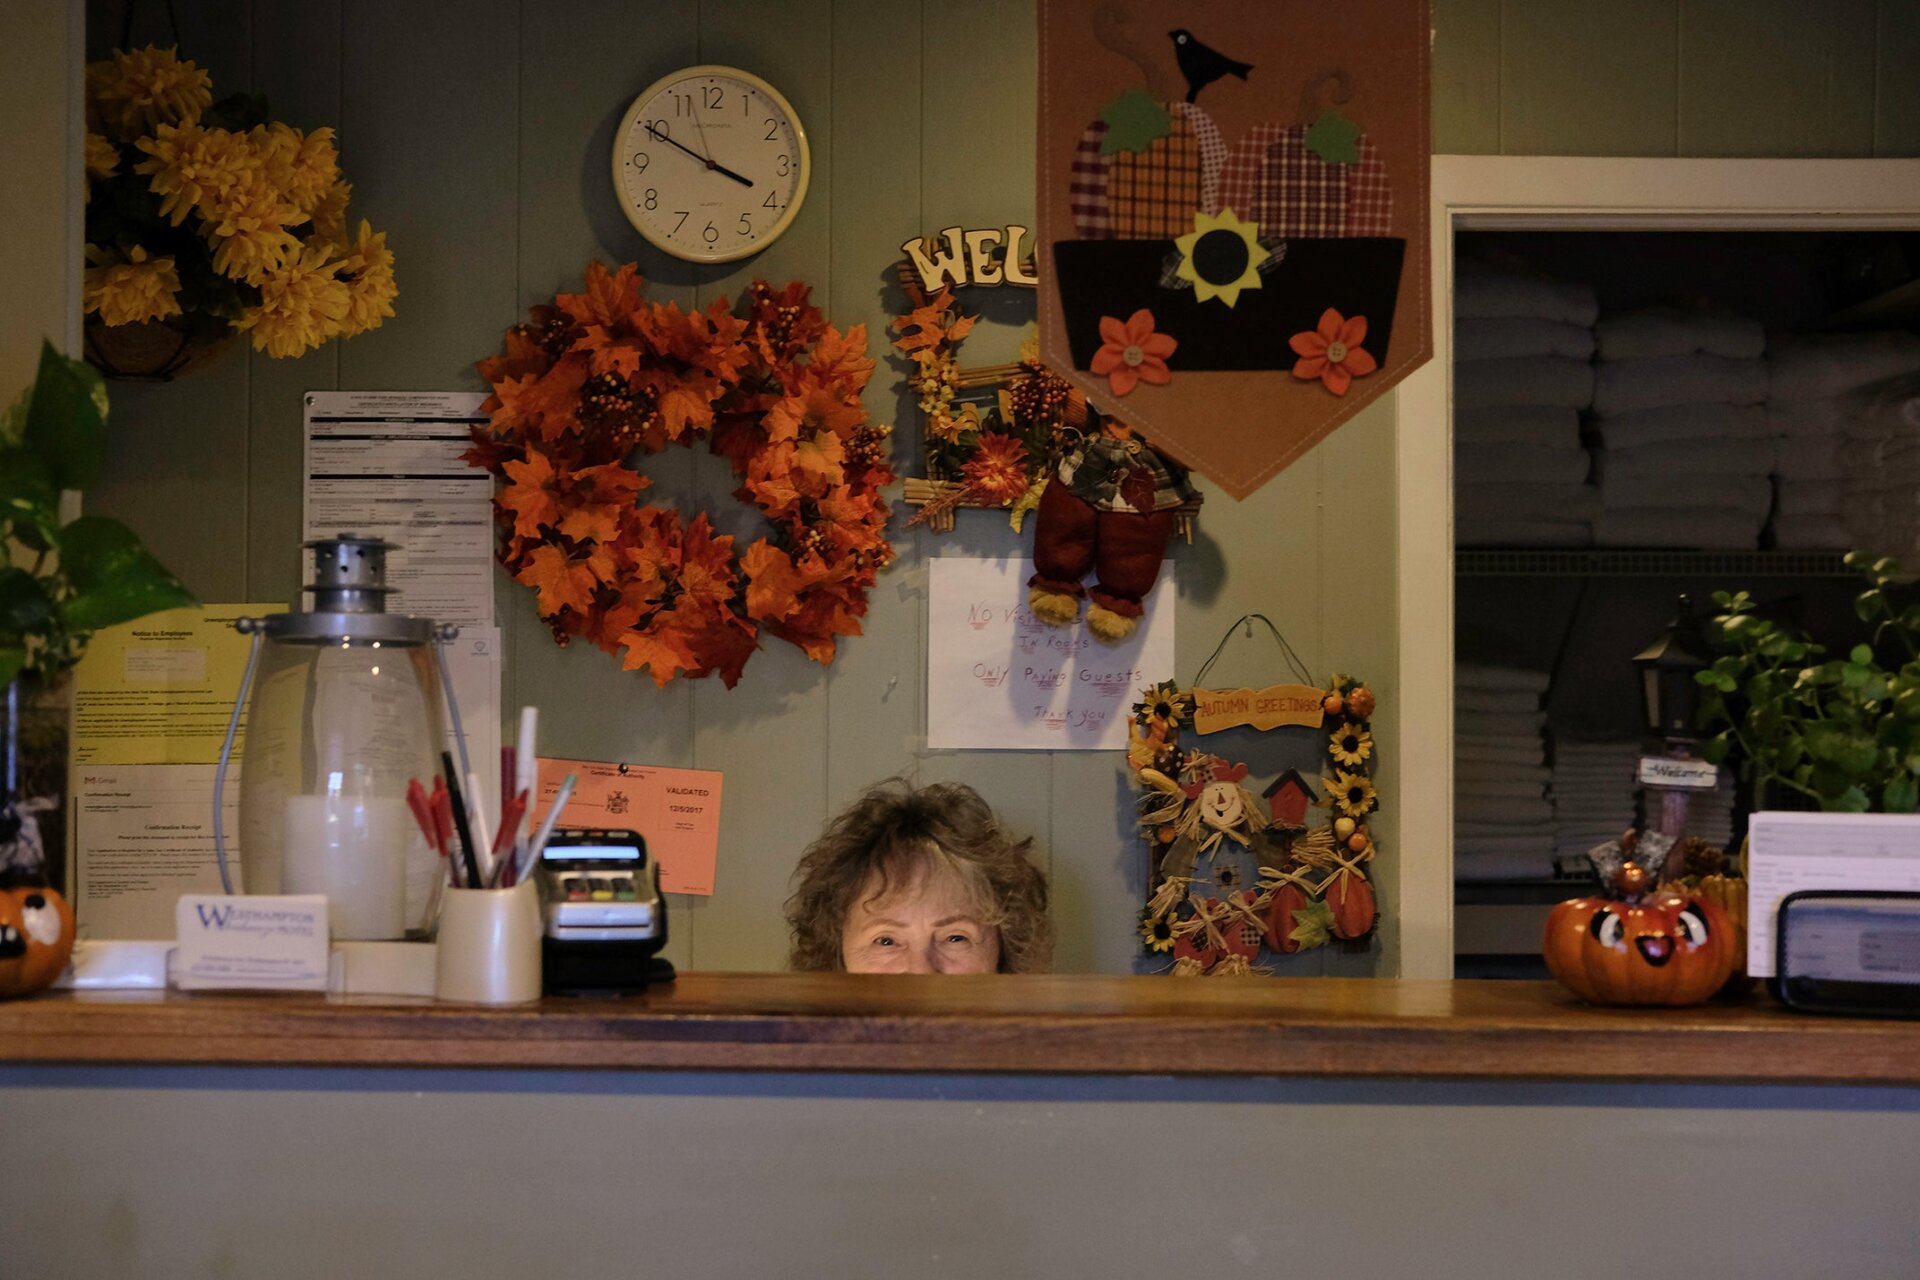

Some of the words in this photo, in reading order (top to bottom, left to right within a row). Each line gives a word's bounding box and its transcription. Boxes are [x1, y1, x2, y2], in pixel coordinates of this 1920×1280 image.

[674, 95, 691, 117] 11
[701, 86, 724, 109] 12
[742, 95, 748, 117] 1
[647, 119, 670, 142] 10
[764, 118, 778, 141] 2
[633, 152, 650, 174] 9
[776, 154, 789, 177] 3
[645, 188, 658, 211] 8
[762, 190, 778, 211] 4
[674, 211, 690, 233] 7
[702, 221, 719, 243] 6
[736, 213, 752, 235] 5
[901, 224, 1039, 293] WEL
[1201, 698, 1249, 718] AUTUMN
[1256, 696, 1318, 714] GREETINGS
[1652, 764, 1706, 779] Welcome
[666, 786, 710, 797] VALIDATED
[669, 804, 704, 814] 12/5/2017
